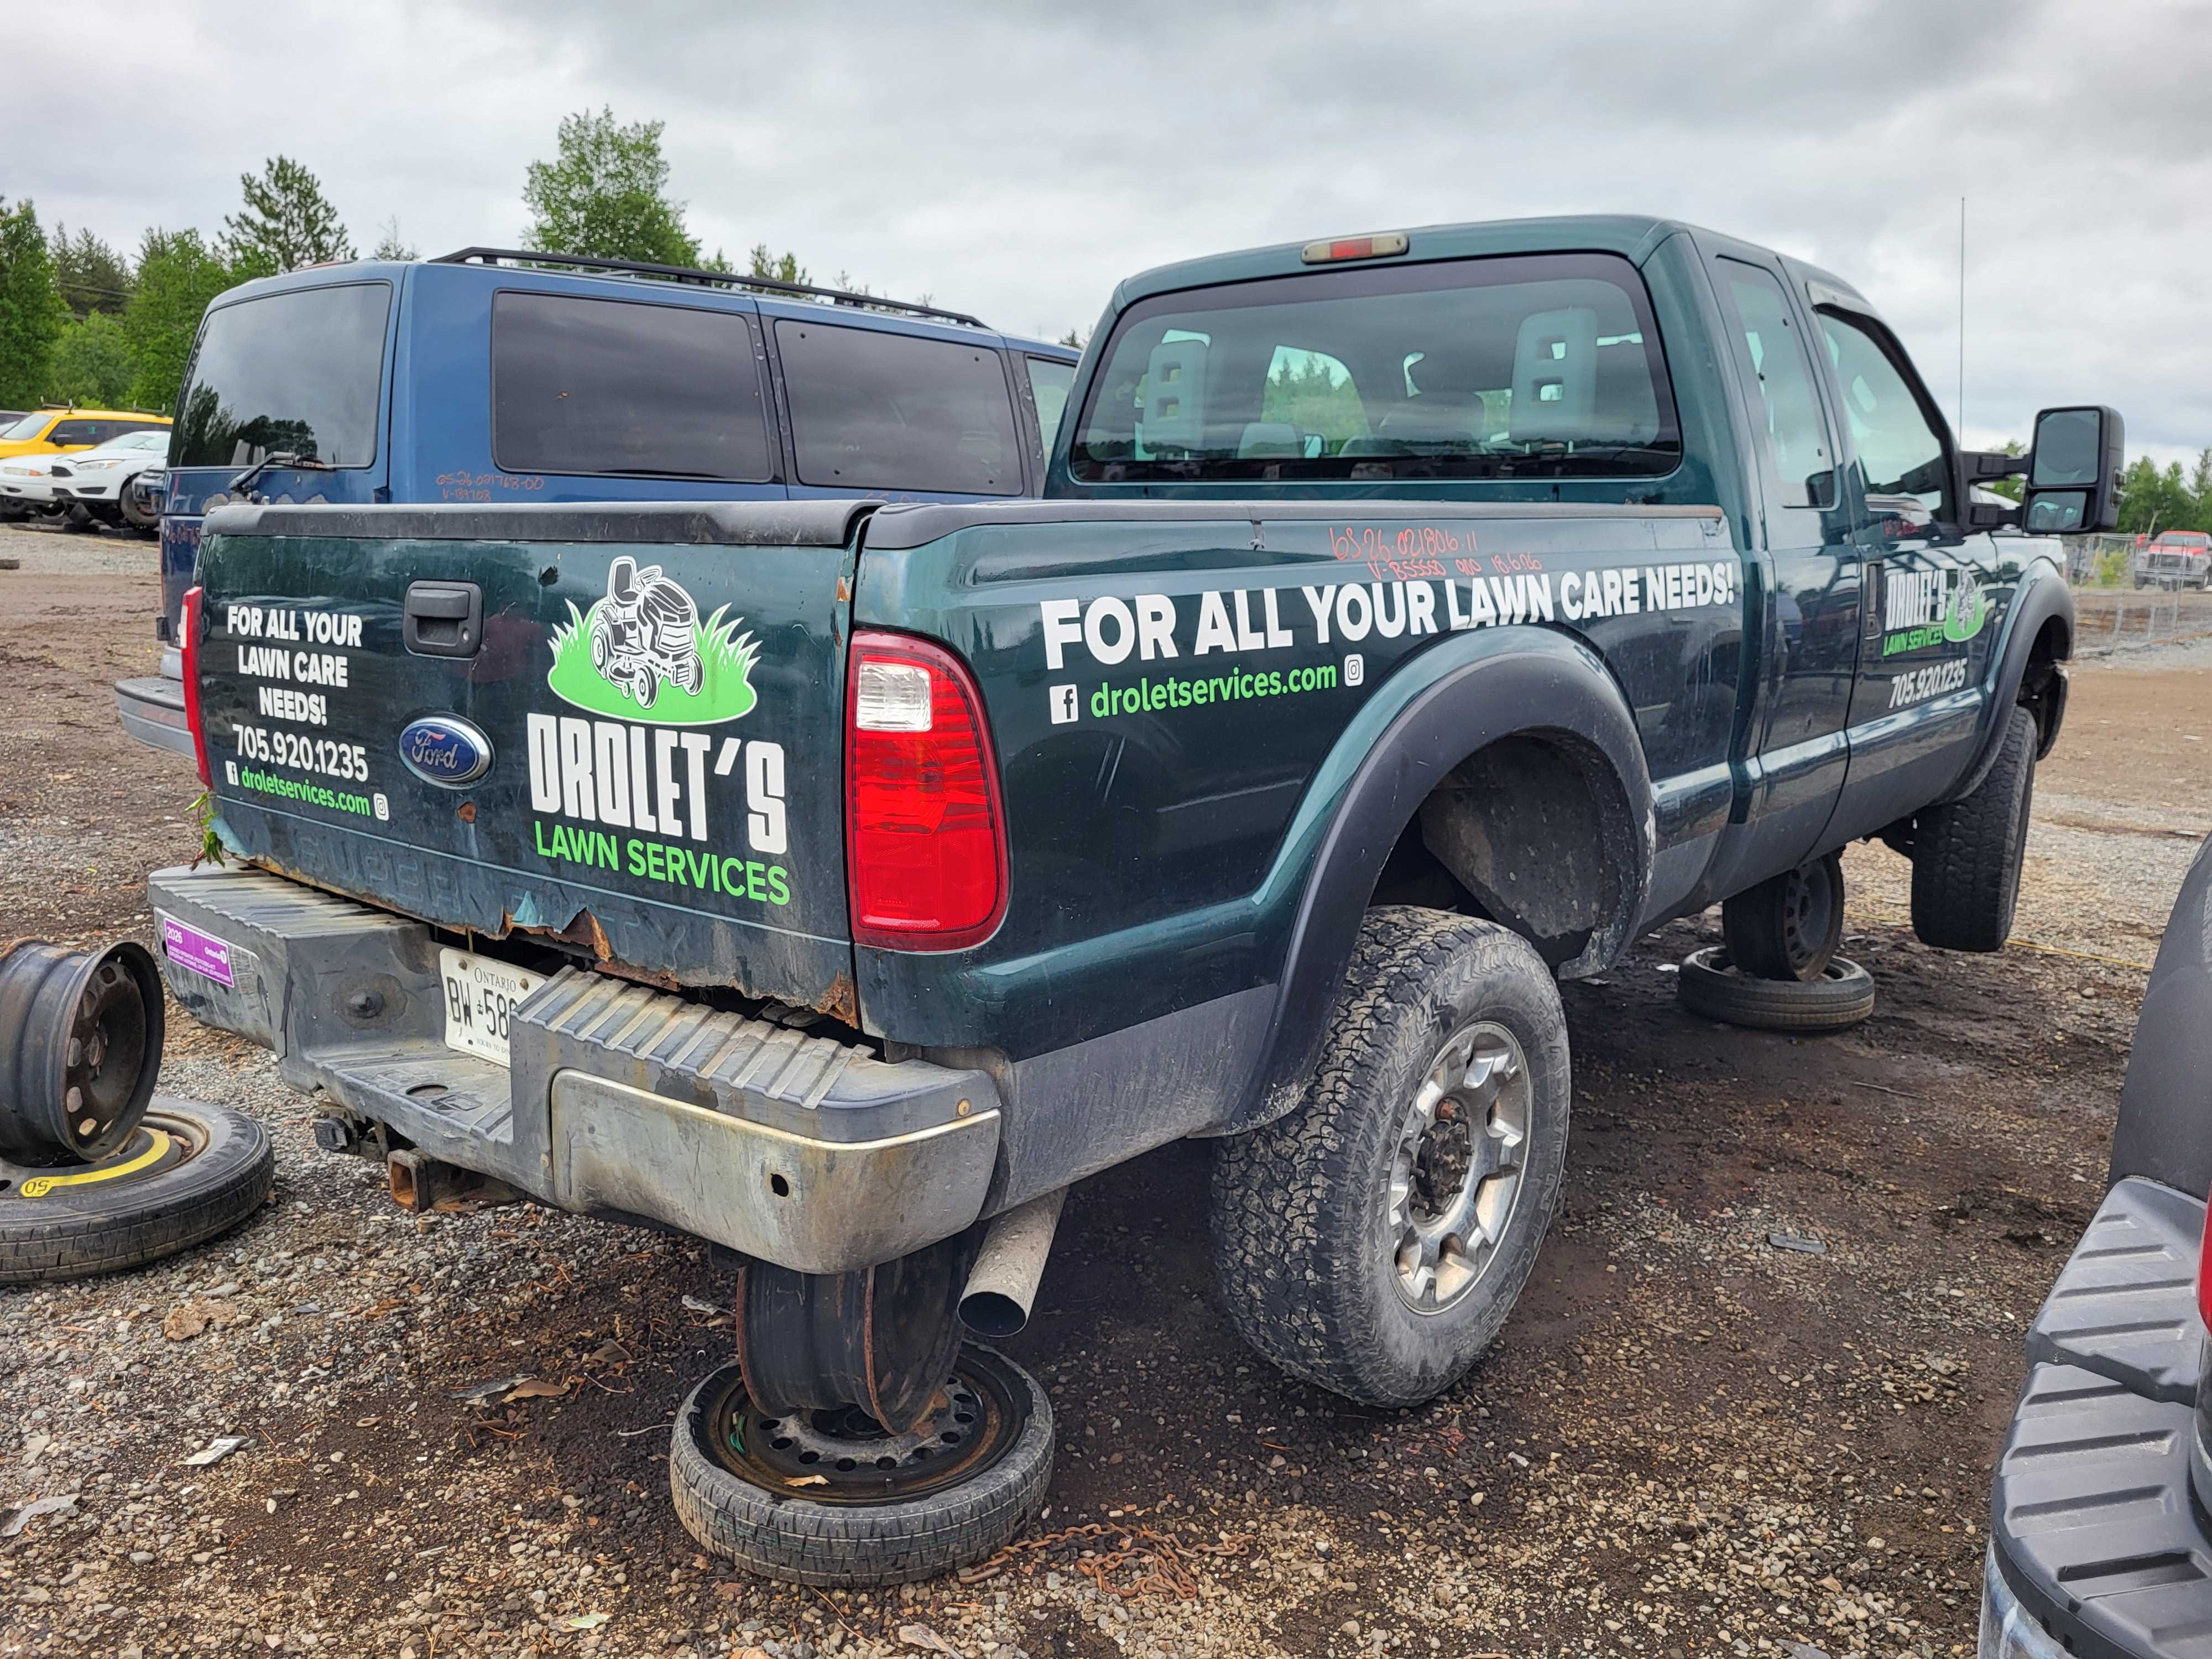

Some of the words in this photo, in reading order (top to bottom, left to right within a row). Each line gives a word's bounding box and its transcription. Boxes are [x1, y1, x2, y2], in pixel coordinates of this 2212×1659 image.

[227, 605, 263, 637] FOR
[265, 608, 300, 641] ALL
[304, 611, 363, 647] YOUR
[1040, 593, 1179, 670] FOR
[1193, 587, 1293, 656] ALL
[1301, 580, 1438, 645] YOUR
[1444, 573, 1554, 632] LAWN
[1559, 566, 1641, 621] CARE
[1646, 562, 1735, 613] NEEDS!
[1885, 569, 1947, 632] DROLET'S
[238, 644, 290, 680] LAWN
[294, 651, 348, 688] CARE
[1882, 632, 1908, 656] LAWN
[1908, 625, 1943, 651] SERVICES
[258, 686, 327, 726] NEEDS!
[1090, 664, 1337, 718] droletservices.com
[1888, 657, 1968, 709] 705.920.1235
[232, 723, 369, 782] 705.920.1235
[411, 728, 459, 769] Ford
[241, 766, 371, 817] droletservices.com
[526, 712, 787, 855] DROLET'S
[535, 820, 619, 872] LAWN
[627, 838, 791, 906] SERVICES
[167, 926, 182, 944] 2026
[446, 976, 473, 1027] BW
[474, 967, 517, 993] ONTARIO
[24, 1180, 50, 1193] 50
